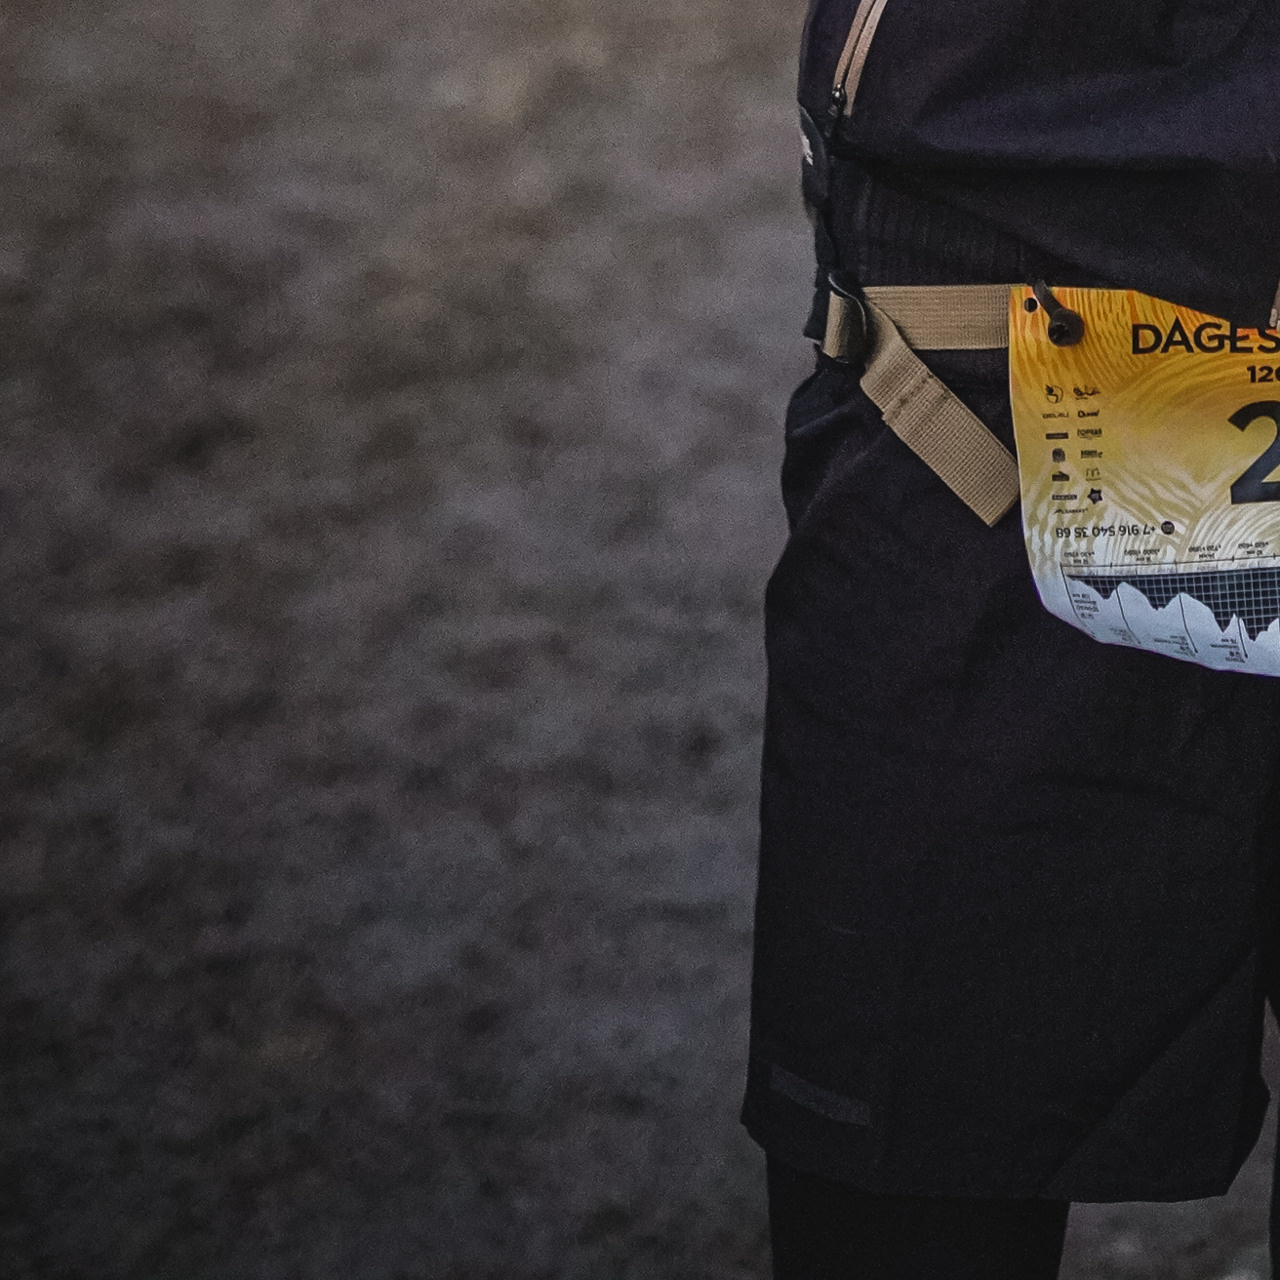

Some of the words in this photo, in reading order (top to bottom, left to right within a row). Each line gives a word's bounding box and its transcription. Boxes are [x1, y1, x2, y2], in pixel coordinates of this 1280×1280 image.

[1055, 527, 1071, 539] 68
[1074, 526, 1089, 538] 35
[1091, 525, 1116, 537] 540
[1118, 524, 1140, 537] 916
